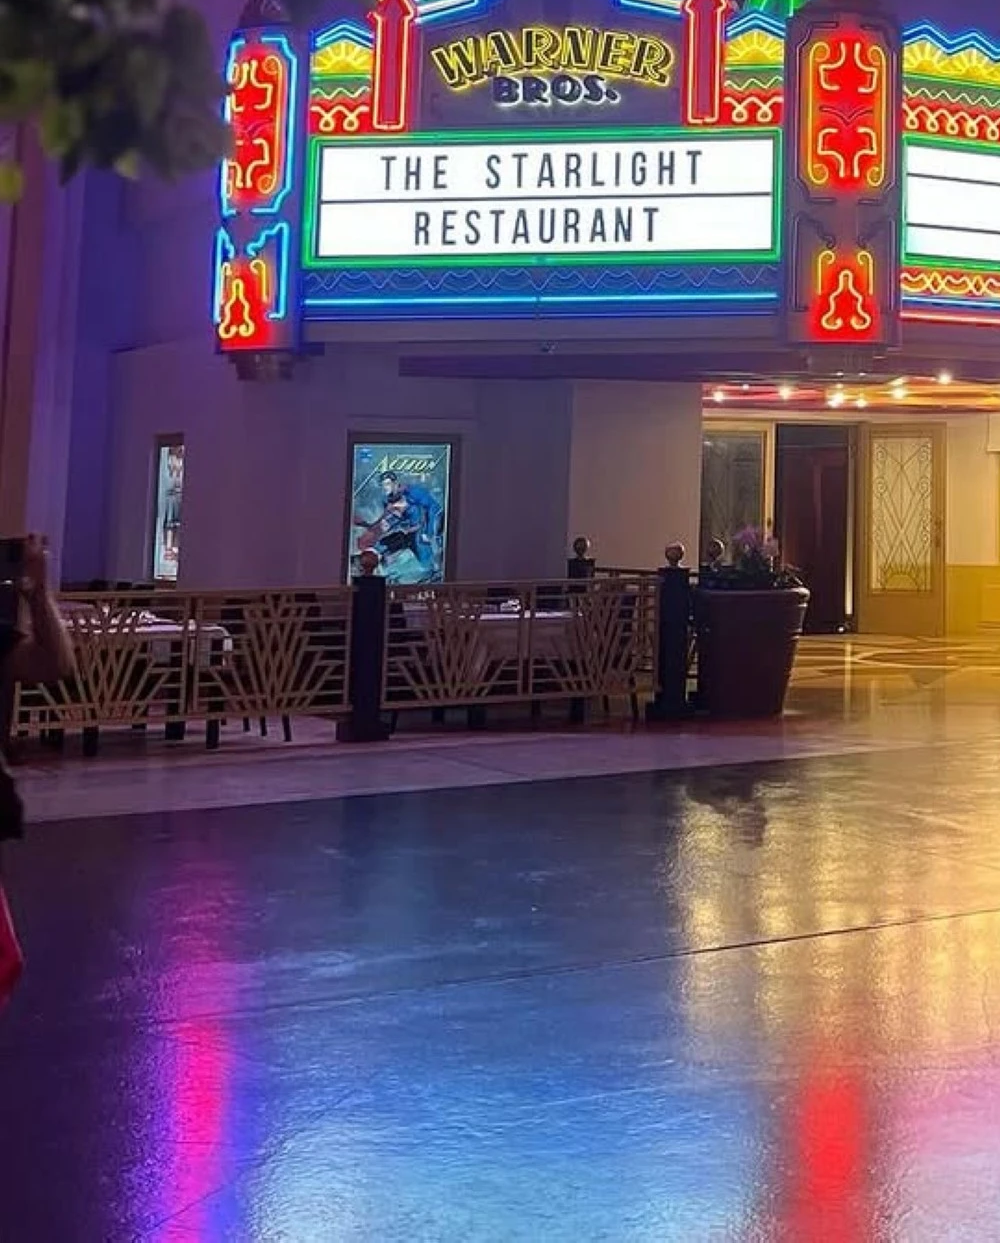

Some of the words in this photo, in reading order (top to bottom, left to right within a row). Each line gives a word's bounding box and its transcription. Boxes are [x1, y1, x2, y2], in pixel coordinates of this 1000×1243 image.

[431, 28, 674, 90] WARNER
[492, 74, 622, 106] BROS.
[381, 155, 448, 190] THE
[485, 150, 702, 189] STARLIGHT
[414, 207, 659, 246] RESTAURANT
